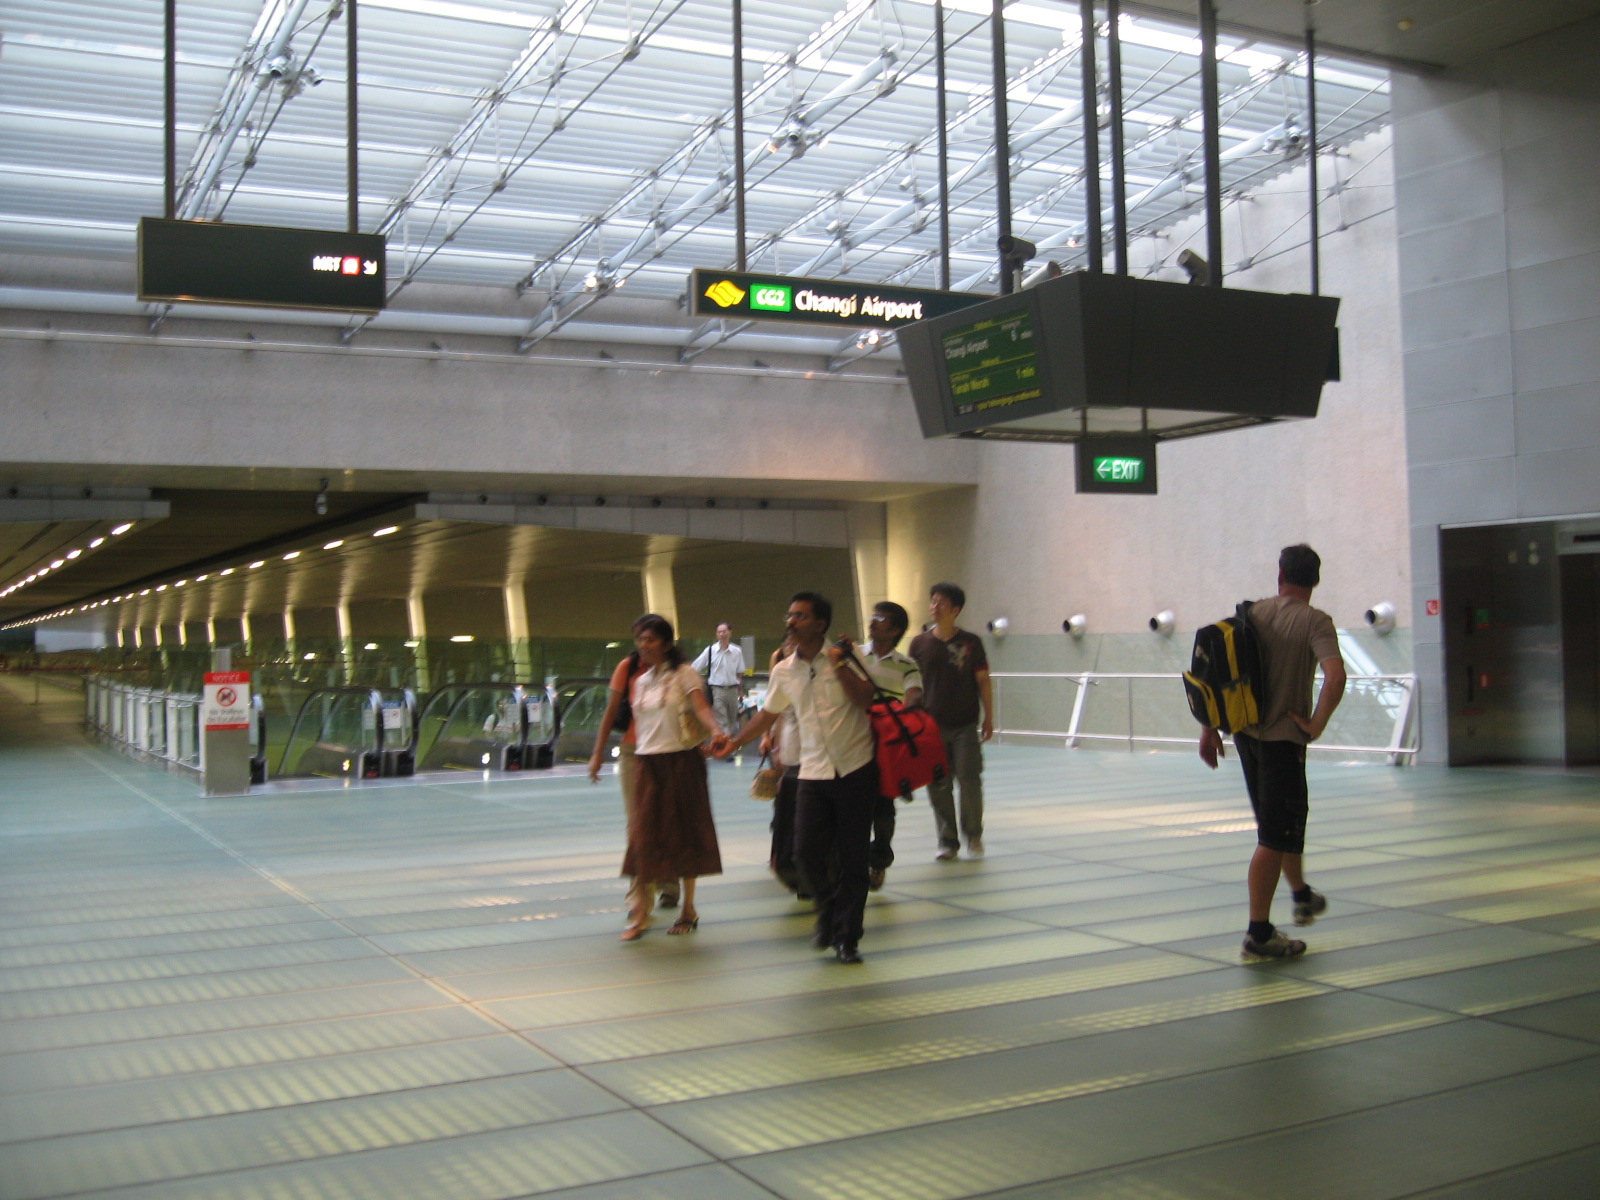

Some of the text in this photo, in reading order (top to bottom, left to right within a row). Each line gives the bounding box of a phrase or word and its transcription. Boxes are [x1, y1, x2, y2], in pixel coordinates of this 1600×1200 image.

[312, 255, 342, 272] MRT
[756, 288, 923, 321] CG2 Changi Airport
[1112, 459, 1141, 480] EXIT
[212, 673, 241, 683] NOTICE
